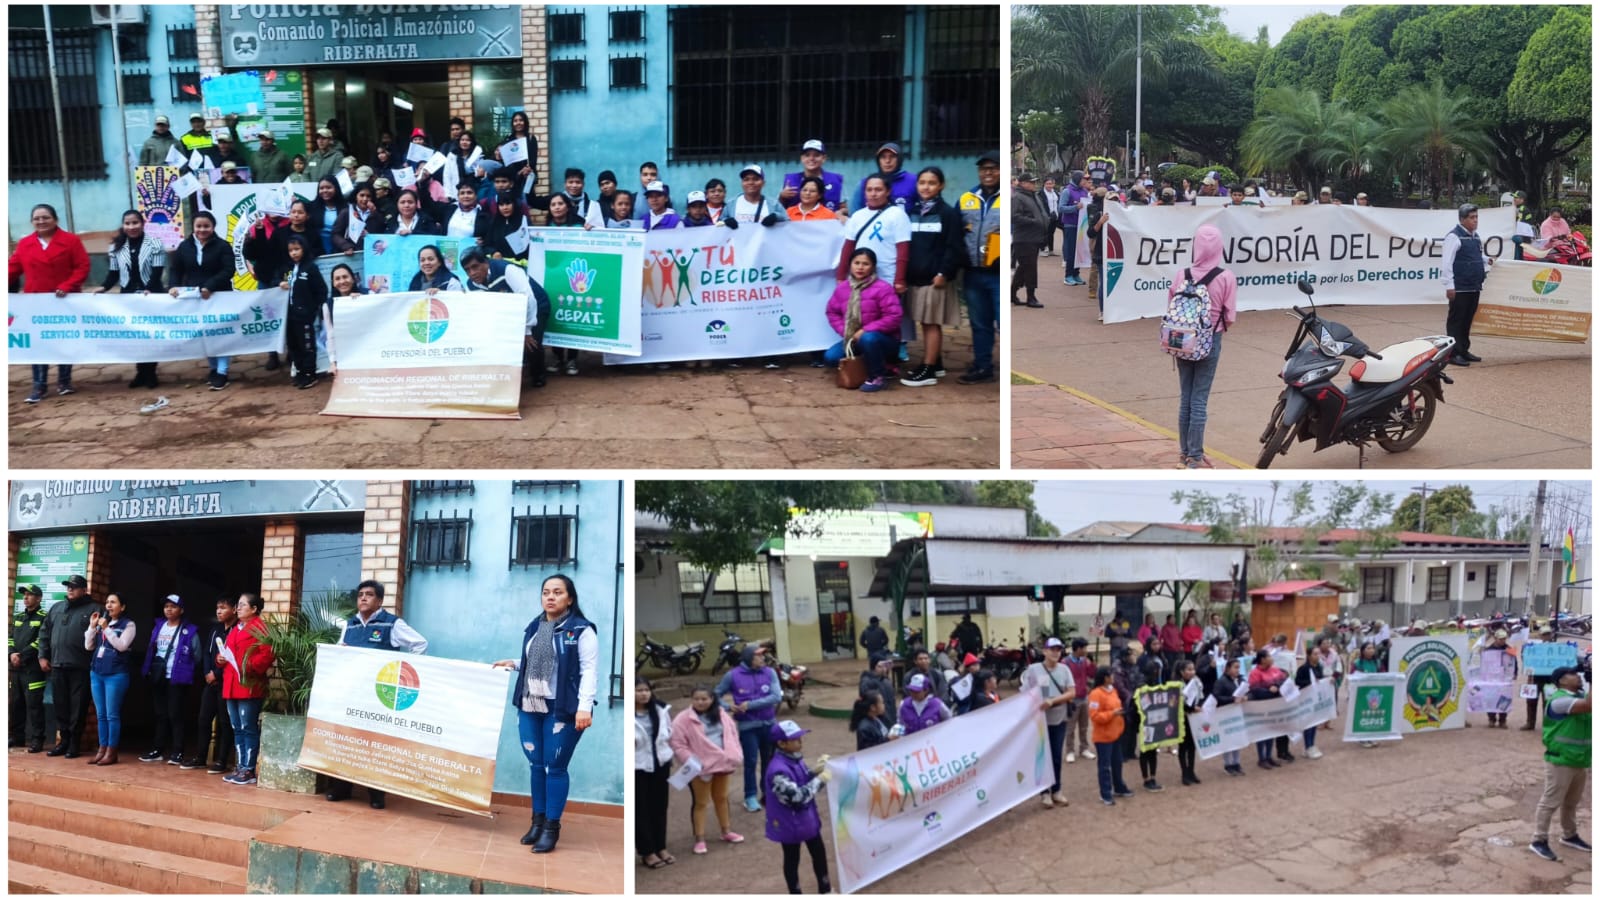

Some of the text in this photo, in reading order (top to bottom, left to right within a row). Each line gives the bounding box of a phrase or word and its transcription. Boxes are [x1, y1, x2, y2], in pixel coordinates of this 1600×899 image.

[258, 14, 475, 41] Comando Policial Amazónico
[323, 43, 418, 61] RIBERALTA
[701, 238, 735, 269] TÚ
[1136, 226, 1503, 266] DEFNSORÍA DEL PUEO
[700, 266, 784, 285] DECIDES
[1134, 276, 1172, 291] Concie
[1236, 271, 1317, 287] prometida
[1320, 275, 1338, 286] por
[1340, 273, 1354, 283] los
[1357, 267, 1424, 282] Derechos
[701, 285, 783, 303] RIBERALTA
[31, 315, 77, 325] GOBIERNO
[131, 314, 199, 325] DEPARTAMENTAL
[202, 313, 218, 323] DEL
[219, 313, 241, 323] BENI
[241, 318, 283, 336] SEDEG
[40, 330, 80, 340] SERVICIO
[84, 329, 150, 340] DEPARTAMENTAL
[154, 330, 165, 340] DE
[205, 327, 235, 337] SOCIAL
[428, 348, 442, 357] DEL
[443, 347, 473, 356] PUEBLO
[449, 374, 461, 383] DE
[107, 492, 221, 519] RIBERALTA
[346, 707, 443, 735] DEFENSORÍA DEL PUEBLO
[312, 727, 369, 747] COORDINACIÓN
[371, 741, 413, 758] REGIONAL
[415, 748, 429, 759] DE
[429, 752, 483, 776] RIBERALTA
[918, 751, 980, 789] DECIDES
[922, 768, 978, 803] RIBERALTA
